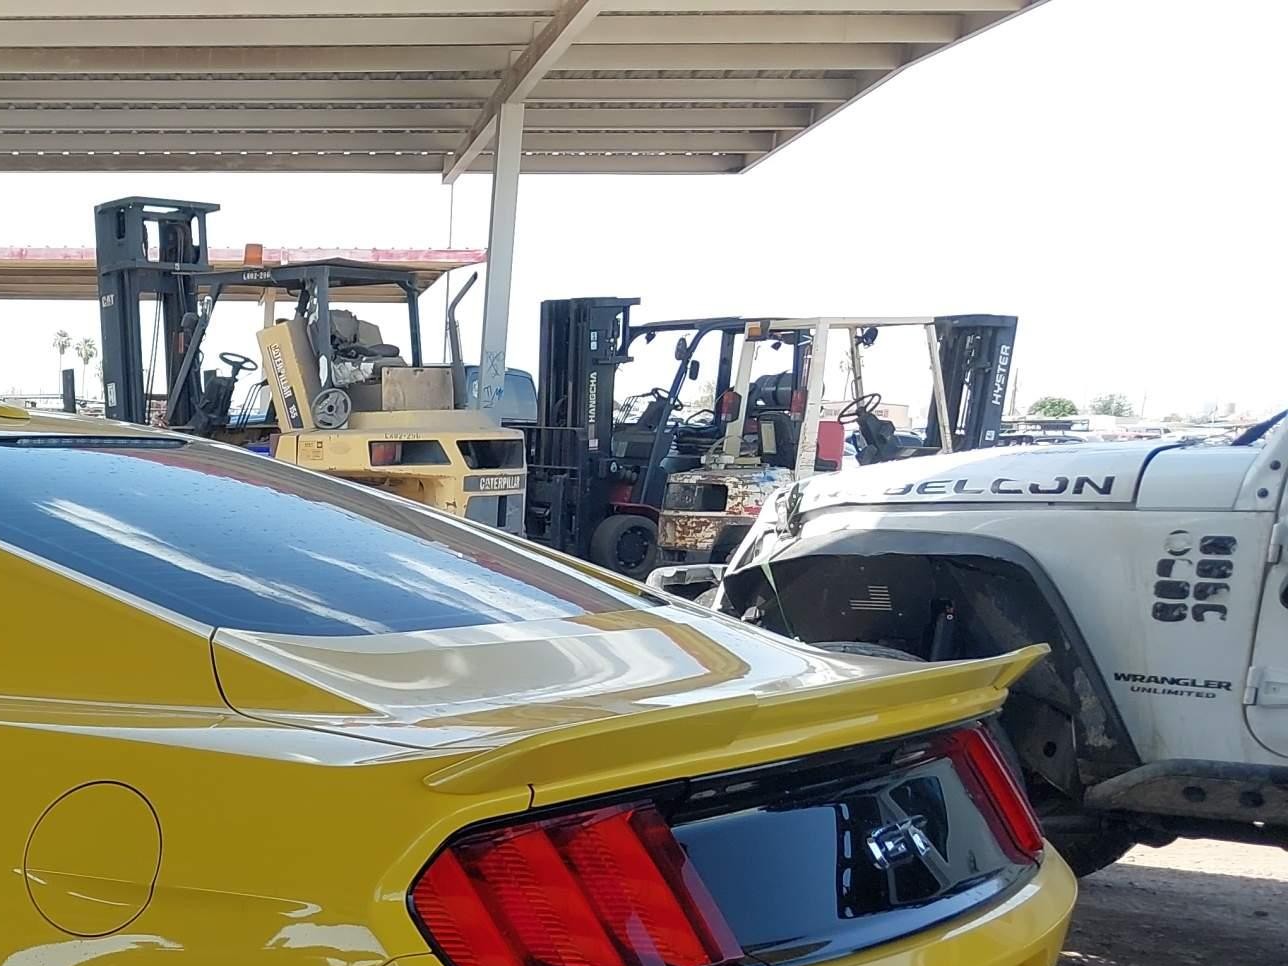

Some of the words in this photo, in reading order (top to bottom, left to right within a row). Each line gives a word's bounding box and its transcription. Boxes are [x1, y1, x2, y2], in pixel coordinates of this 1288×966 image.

[101, 294, 115, 308] CAT
[271, 343, 292, 399] CATERPILLAR
[992, 344, 1011, 406] HYSTER
[588, 371, 598, 423] HANGCHA
[479, 475, 520, 490] CATERPILLAR
[1113, 672, 1233, 692] WRANGLER
[1130, 685, 1217, 699] UNLIMITED
